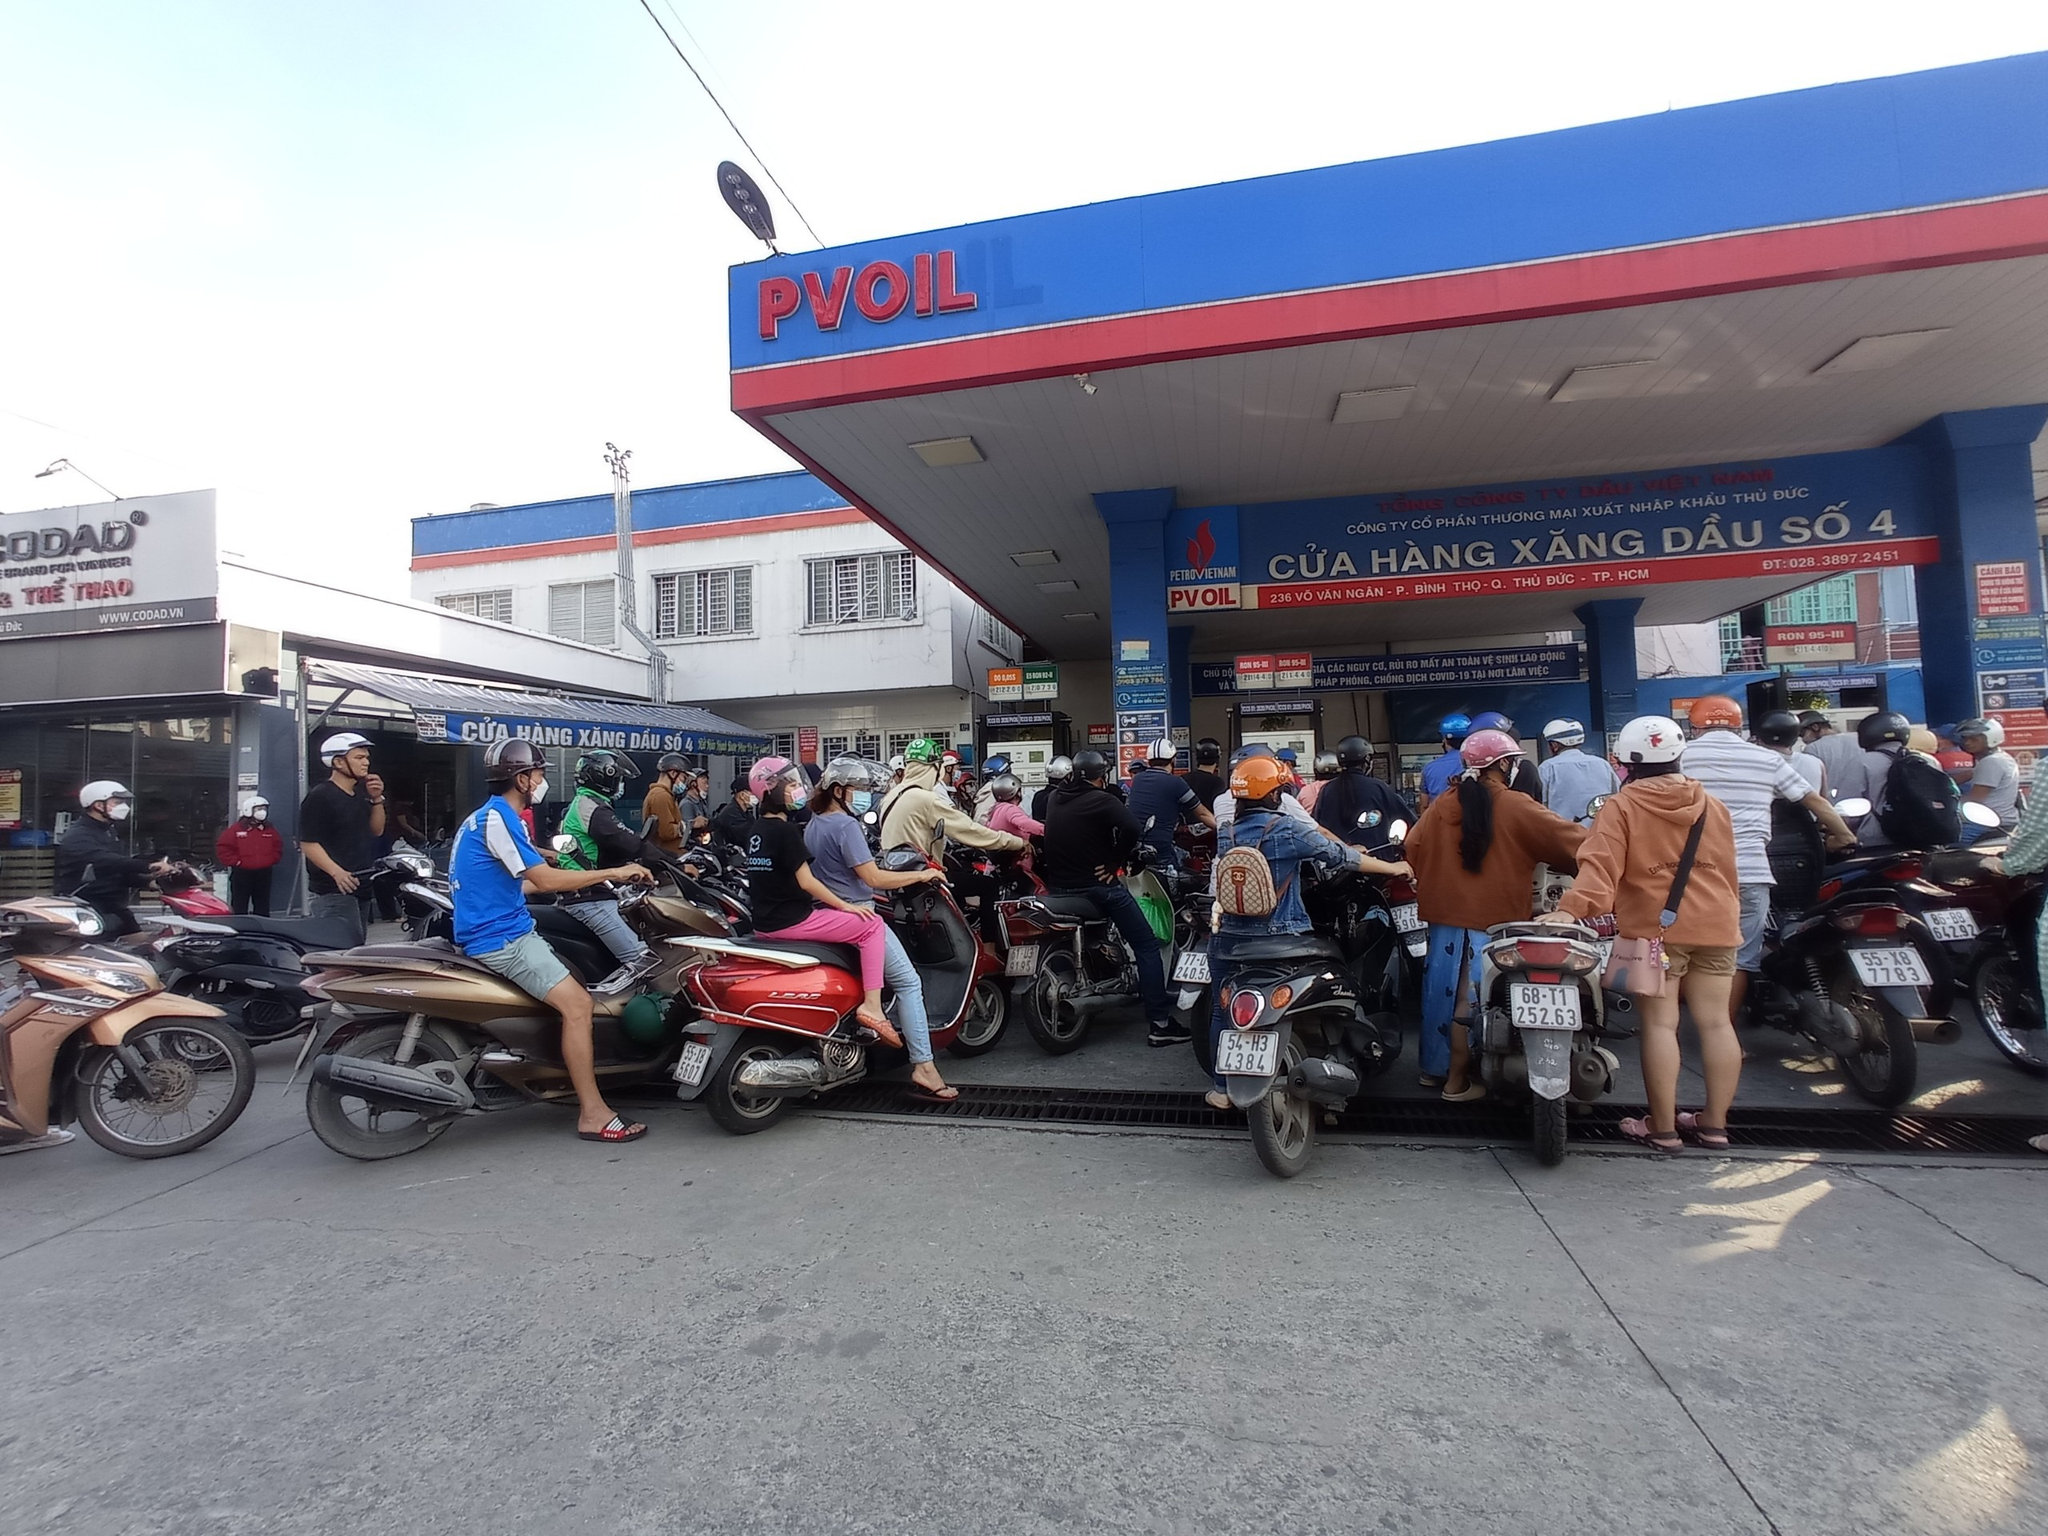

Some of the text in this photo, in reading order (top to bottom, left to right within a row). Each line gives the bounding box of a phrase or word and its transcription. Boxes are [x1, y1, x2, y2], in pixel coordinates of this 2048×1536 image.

[759, 250, 977, 340] PVOIL
[1537, 487, 1568, 500] TY
[1347, 519, 1386, 535] CÔNG
[1390, 521, 1407, 532] TY
[1411, 514, 1432, 530] CỔ
[1481, 510, 1545, 524] THƯƠNG
[1549, 508, 1576, 521] MẠI
[1582, 501, 1624, 517] XUẤT
[1630, 499, 1674, 515] NHẬP
[1680, 491, 1726, 508] KHẨU
[1733, 489, 1766, 504] THỦ
[1773, 486, 1810, 501] ĐỨC
[1268, 500, 1898, 580] CỬA HÀNG XĂNG DẦU SỐ 4
[50, 562, 76, 574] FOR
[77, 556, 131, 571] WINNER
[1170, 566, 1236, 581] PETROVIETNAM
[70, 578, 133, 601] THAO
[1270, 593, 1292, 604] 236
[1295, 589, 1313, 602] VÕ
[1317, 587, 1342, 600] VĂN
[1346, 586, 1384, 599] NGÂN
[1396, 586, 1409, 596] P.
[1415, 582, 1446, 594] BÌNH
[1513, 574, 1541, 588] THỦ
[1546, 572, 1575, 586] ĐỨC
[1592, 571, 1614, 582] TP.
[1618, 569, 1650, 581] HCM
[99, 607, 184, 624] WWW.CODAD.VN
[1777, 630, 1844, 641] RON 95-III
[1203, 667, 1221, 678] CHỦ
[1328, 662, 1345, 673] CÁC
[1347, 662, 1370, 673] NGUY
[1406, 659, 1418, 669] RO
[1420, 656, 1439, 668] MẤT
[1442, 658, 1454, 667] AN
[1457, 655, 1480, 666] TOÀN
[1482, 654, 1494, 666] VỆ
[1496, 653, 1518, 664] SINH
[1520, 652, 1537, 663] LAO
[1540, 651, 1566, 663] ĐỘNG
[1218, 681, 1230, 690] VÀ
[1315, 675, 1337, 687] PHÁP
[1374, 672, 1403, 684] CHỐNG
[1429, 670, 1469, 682] COVID-19
[1471, 670, 1485, 681] TẠI
[1488, 667, 1504, 678] NƠI
[1506, 666, 1527, 677] LÀM
[1528, 665, 1549, 677] VIỆC
[462, 716, 508, 741] CỬA
[517, 722, 573, 746] HÀNG
[578, 726, 625, 748] XĂNG
[630, 728, 660, 750] DẦU
[664, 731, 682, 751] SỐ
[685, 739, 693, 752] 4
[1933, 924, 1977, 939] 642.92
[1861, 952, 1912, 966] 55-X8
[1868, 967, 1920, 983] 7783
[1522, 987, 1566, 1005] 68-T1
[1516, 1007, 1577, 1026] 252.63
[1227, 1034, 1269, 1052] 54-H3
[678, 1061, 700, 1081] 5607
[1225, 1053, 1265, 1071] 4384
